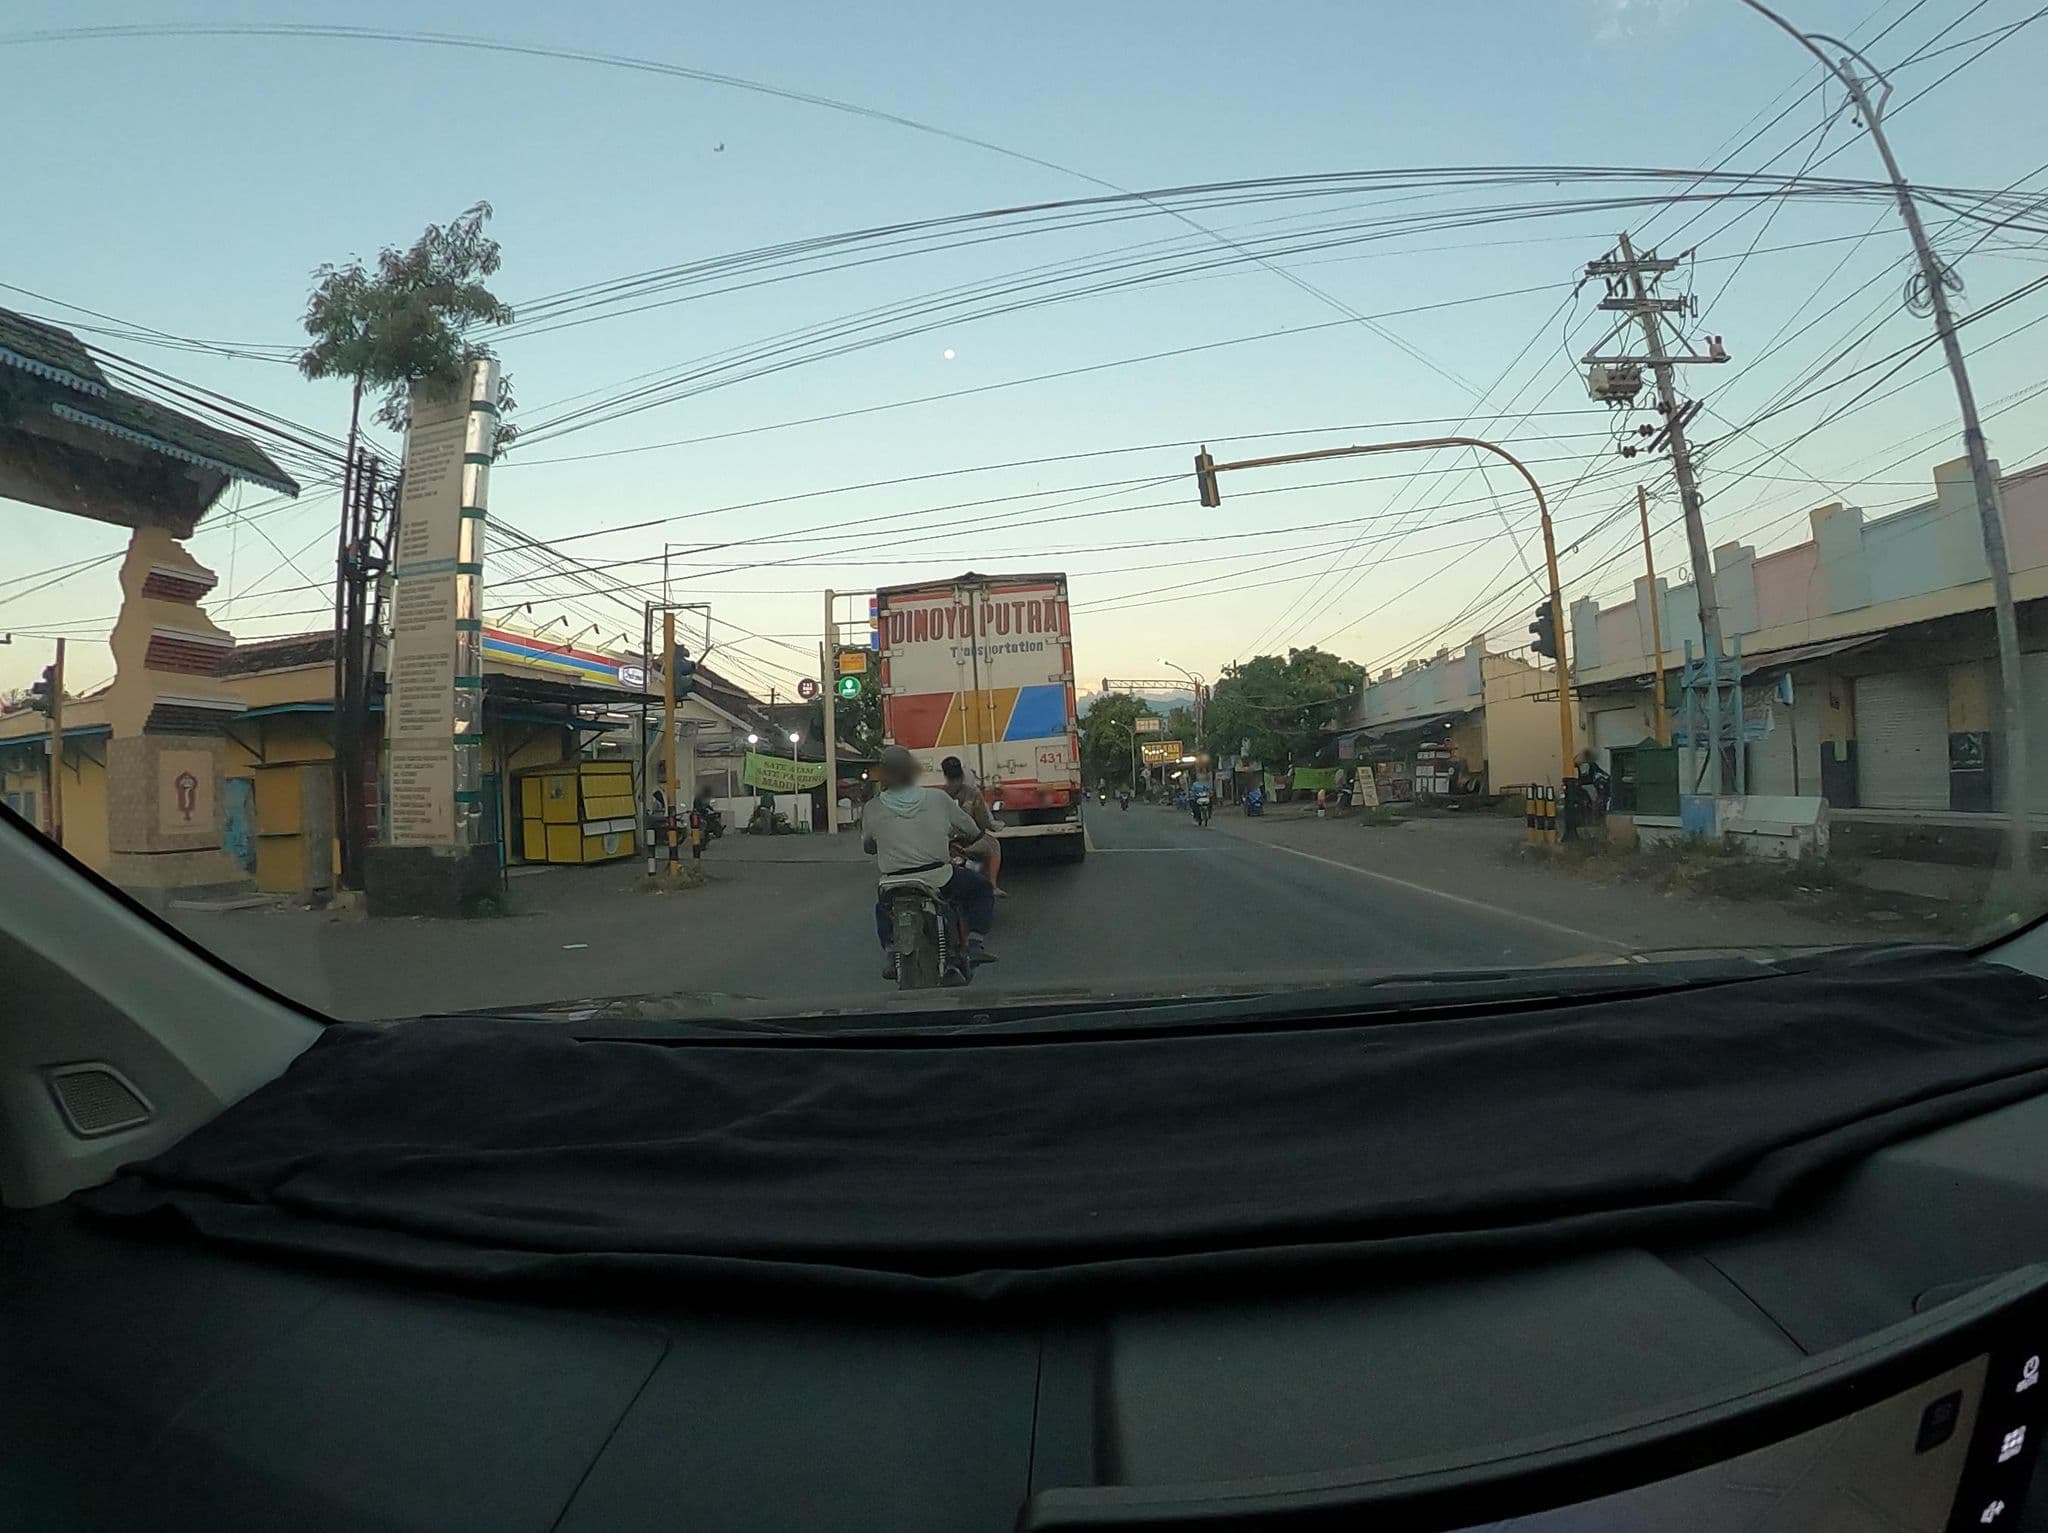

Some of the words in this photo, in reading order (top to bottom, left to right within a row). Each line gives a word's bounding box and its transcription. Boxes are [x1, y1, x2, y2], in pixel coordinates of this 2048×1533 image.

[890, 605, 973, 644] DINOYO
[980, 598, 1058, 637] PUTRA
[950, 641, 1043, 658] Tasortation
[1040, 752, 1061, 763] 431
